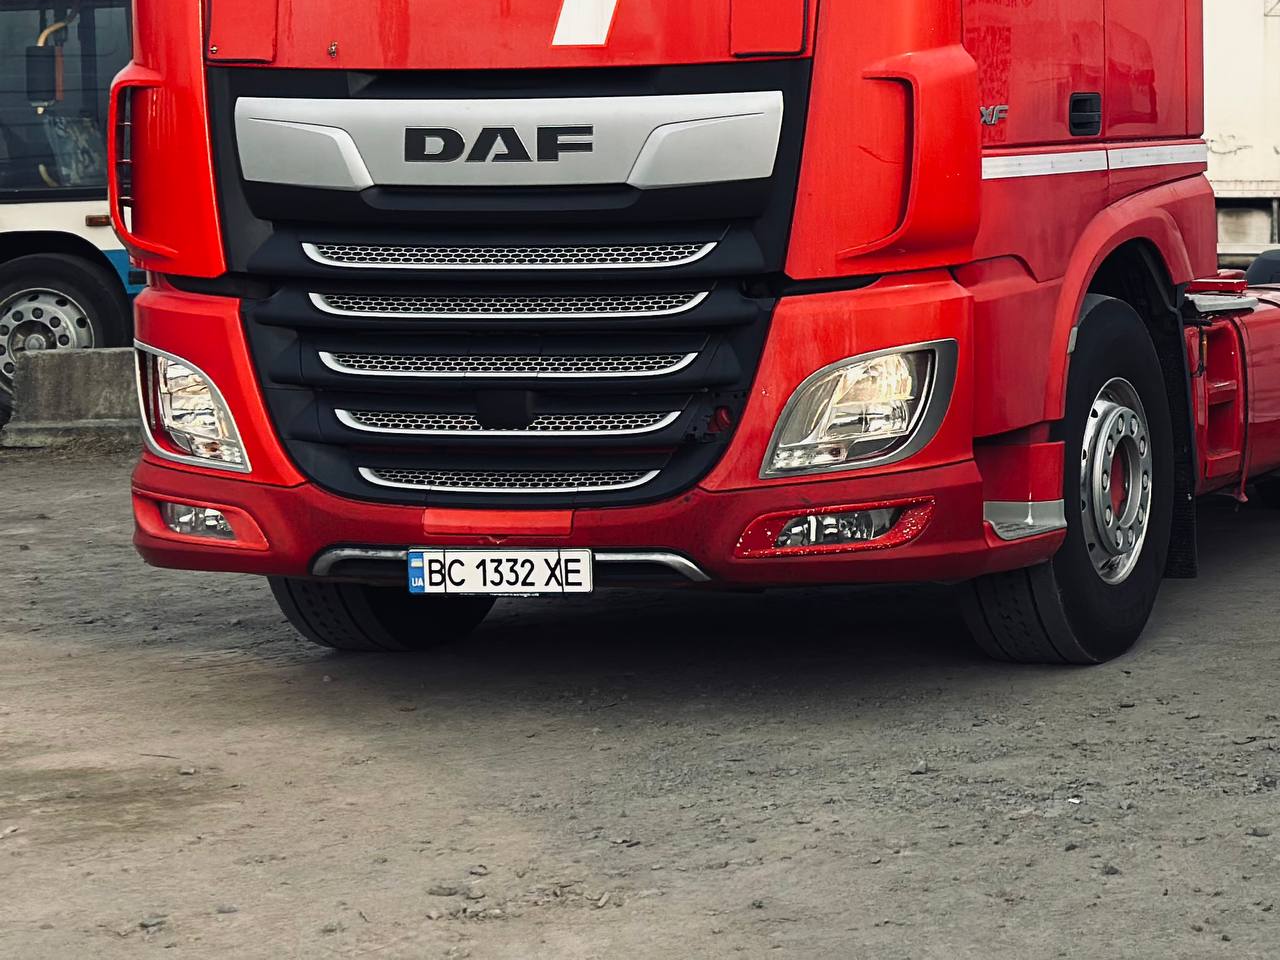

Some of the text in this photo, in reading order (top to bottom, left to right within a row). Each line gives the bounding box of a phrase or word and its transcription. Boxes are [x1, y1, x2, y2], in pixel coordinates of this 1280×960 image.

[404, 125, 594, 162] DAF
[411, 578, 424, 587] UA
[428, 558, 583, 587] BC 1332 XE
